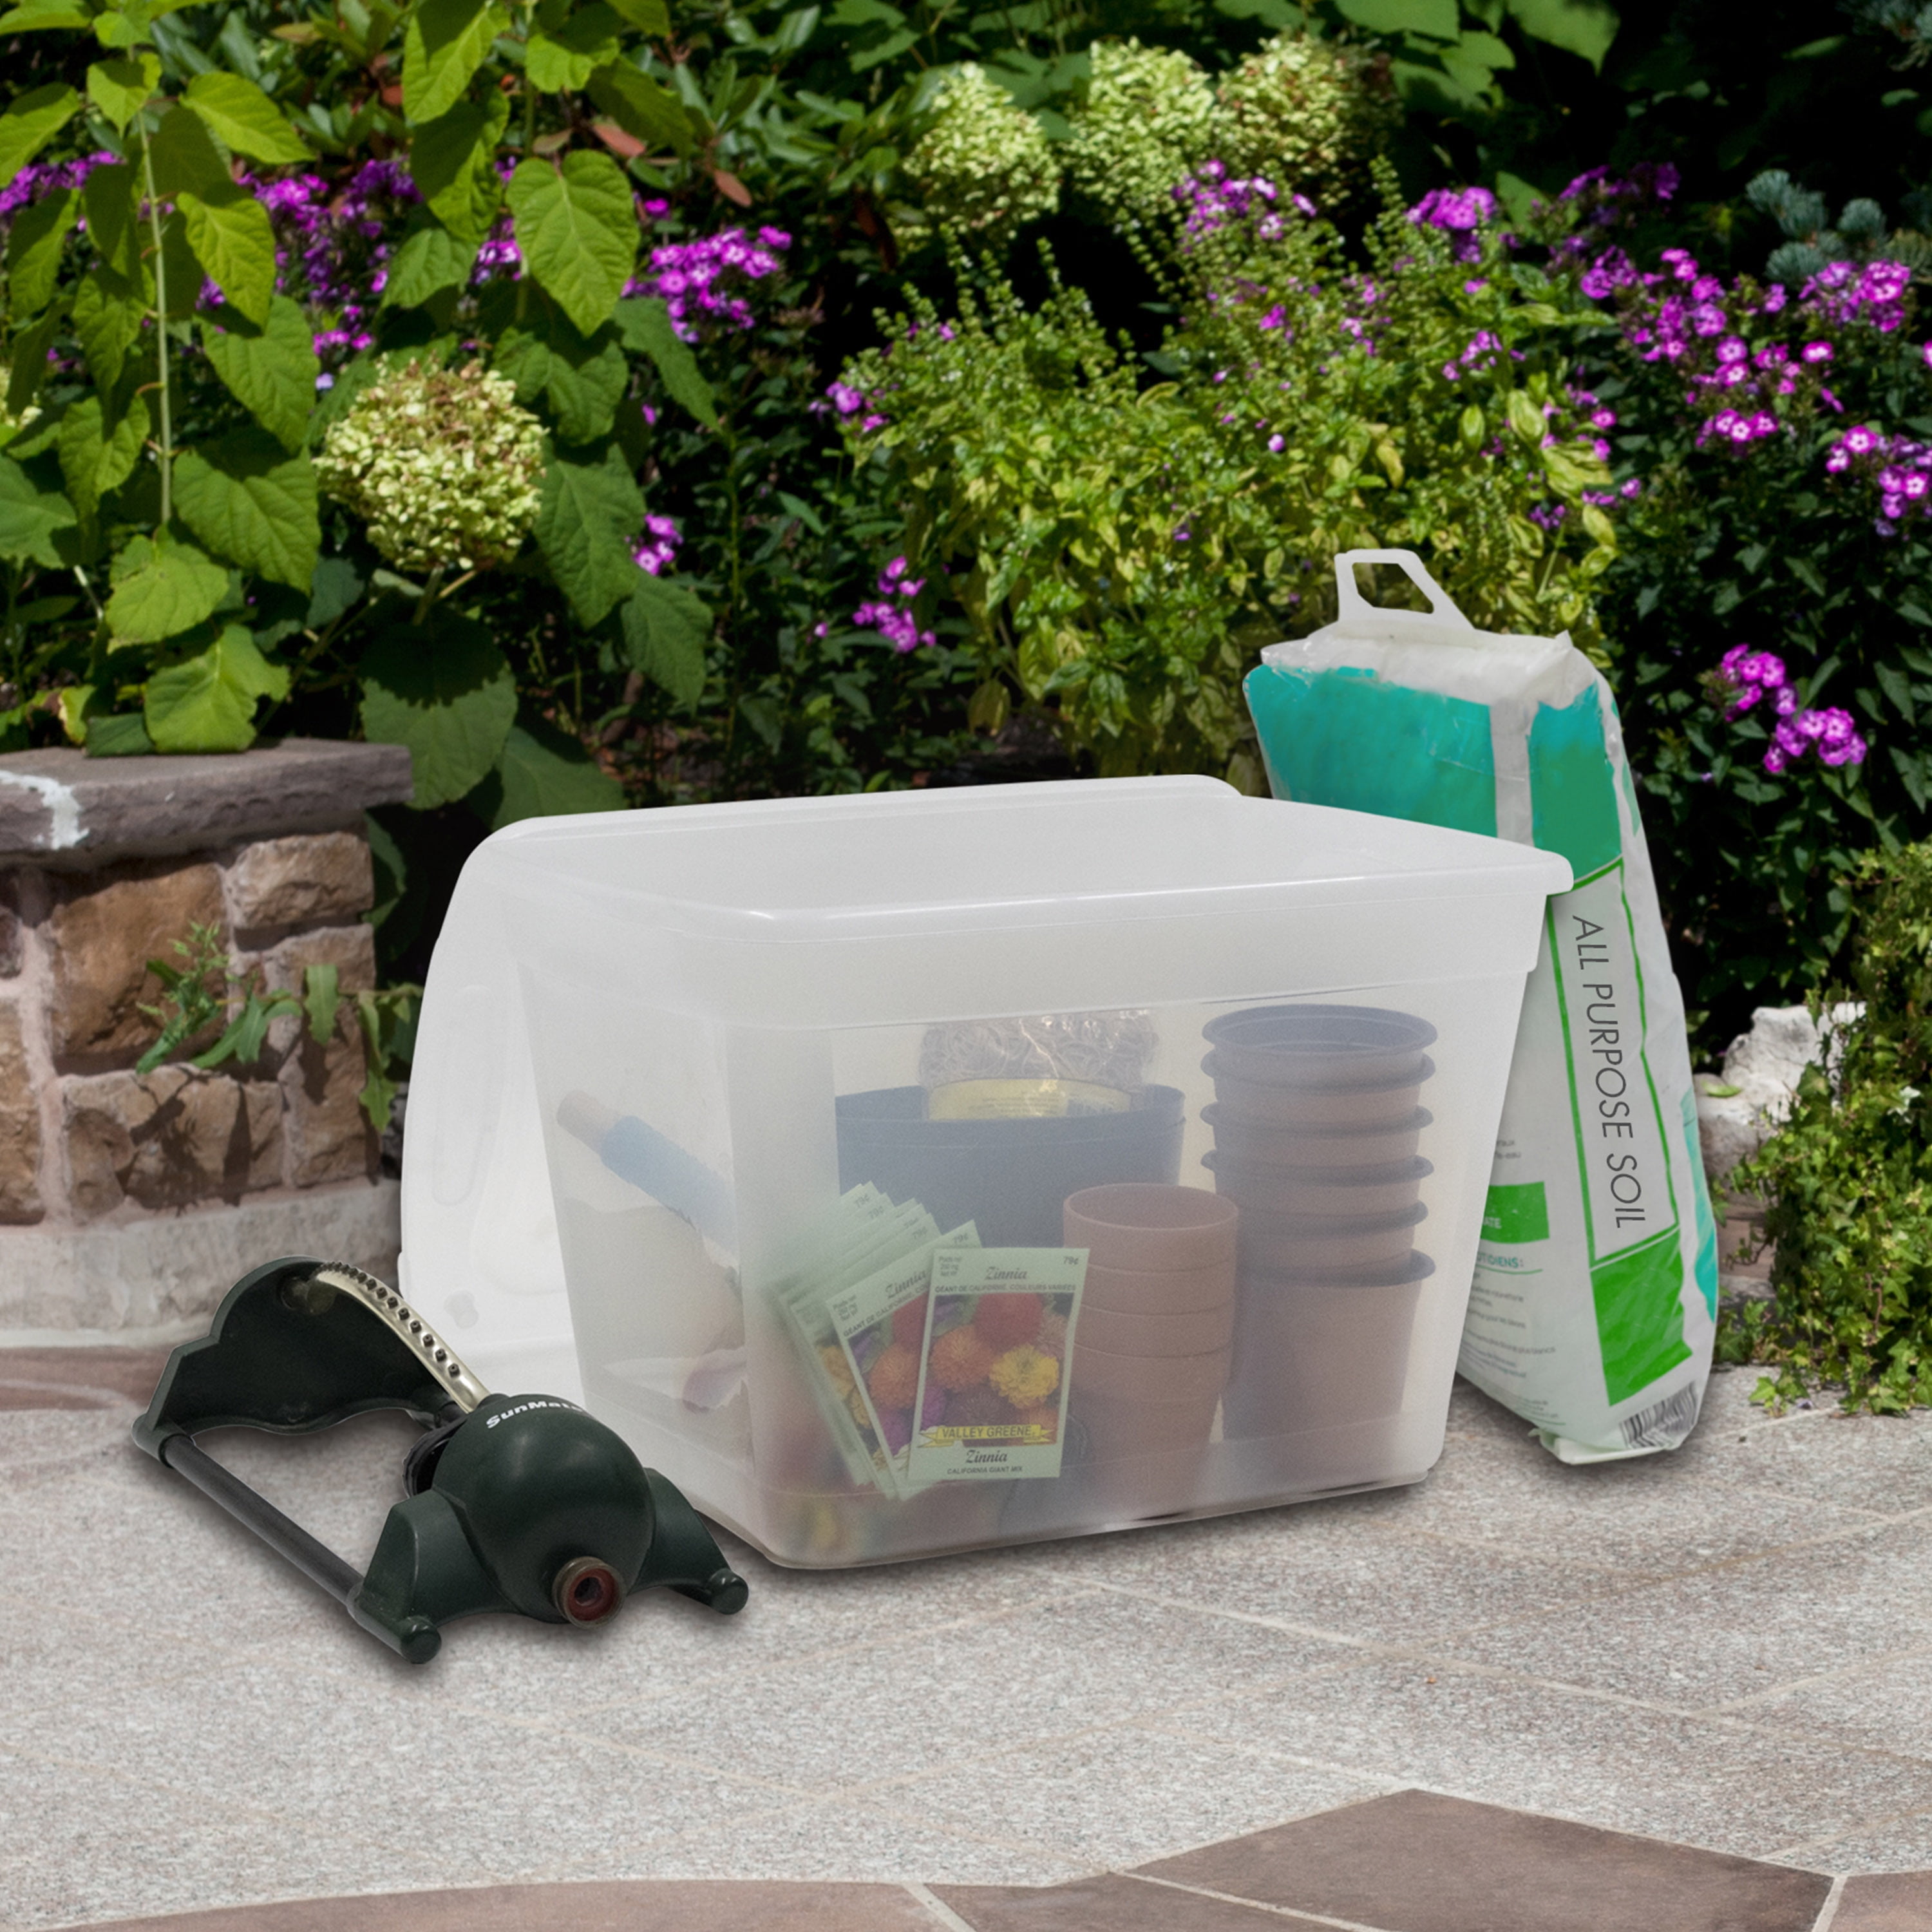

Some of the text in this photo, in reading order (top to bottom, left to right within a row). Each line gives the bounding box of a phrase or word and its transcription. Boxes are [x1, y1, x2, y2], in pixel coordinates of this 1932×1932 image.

[1573, 915, 1646, 1229] ALL PURPOSE SOIL
[1063, 1256, 1079, 1265] 79¢
[985, 1265, 1028, 1281] Zinnia
[886, 1271, 927, 1300] Zinnia
[942, 1425, 1032, 1439] VALLEY GREENE
[965, 1449, 1008, 1464] Zinnia
